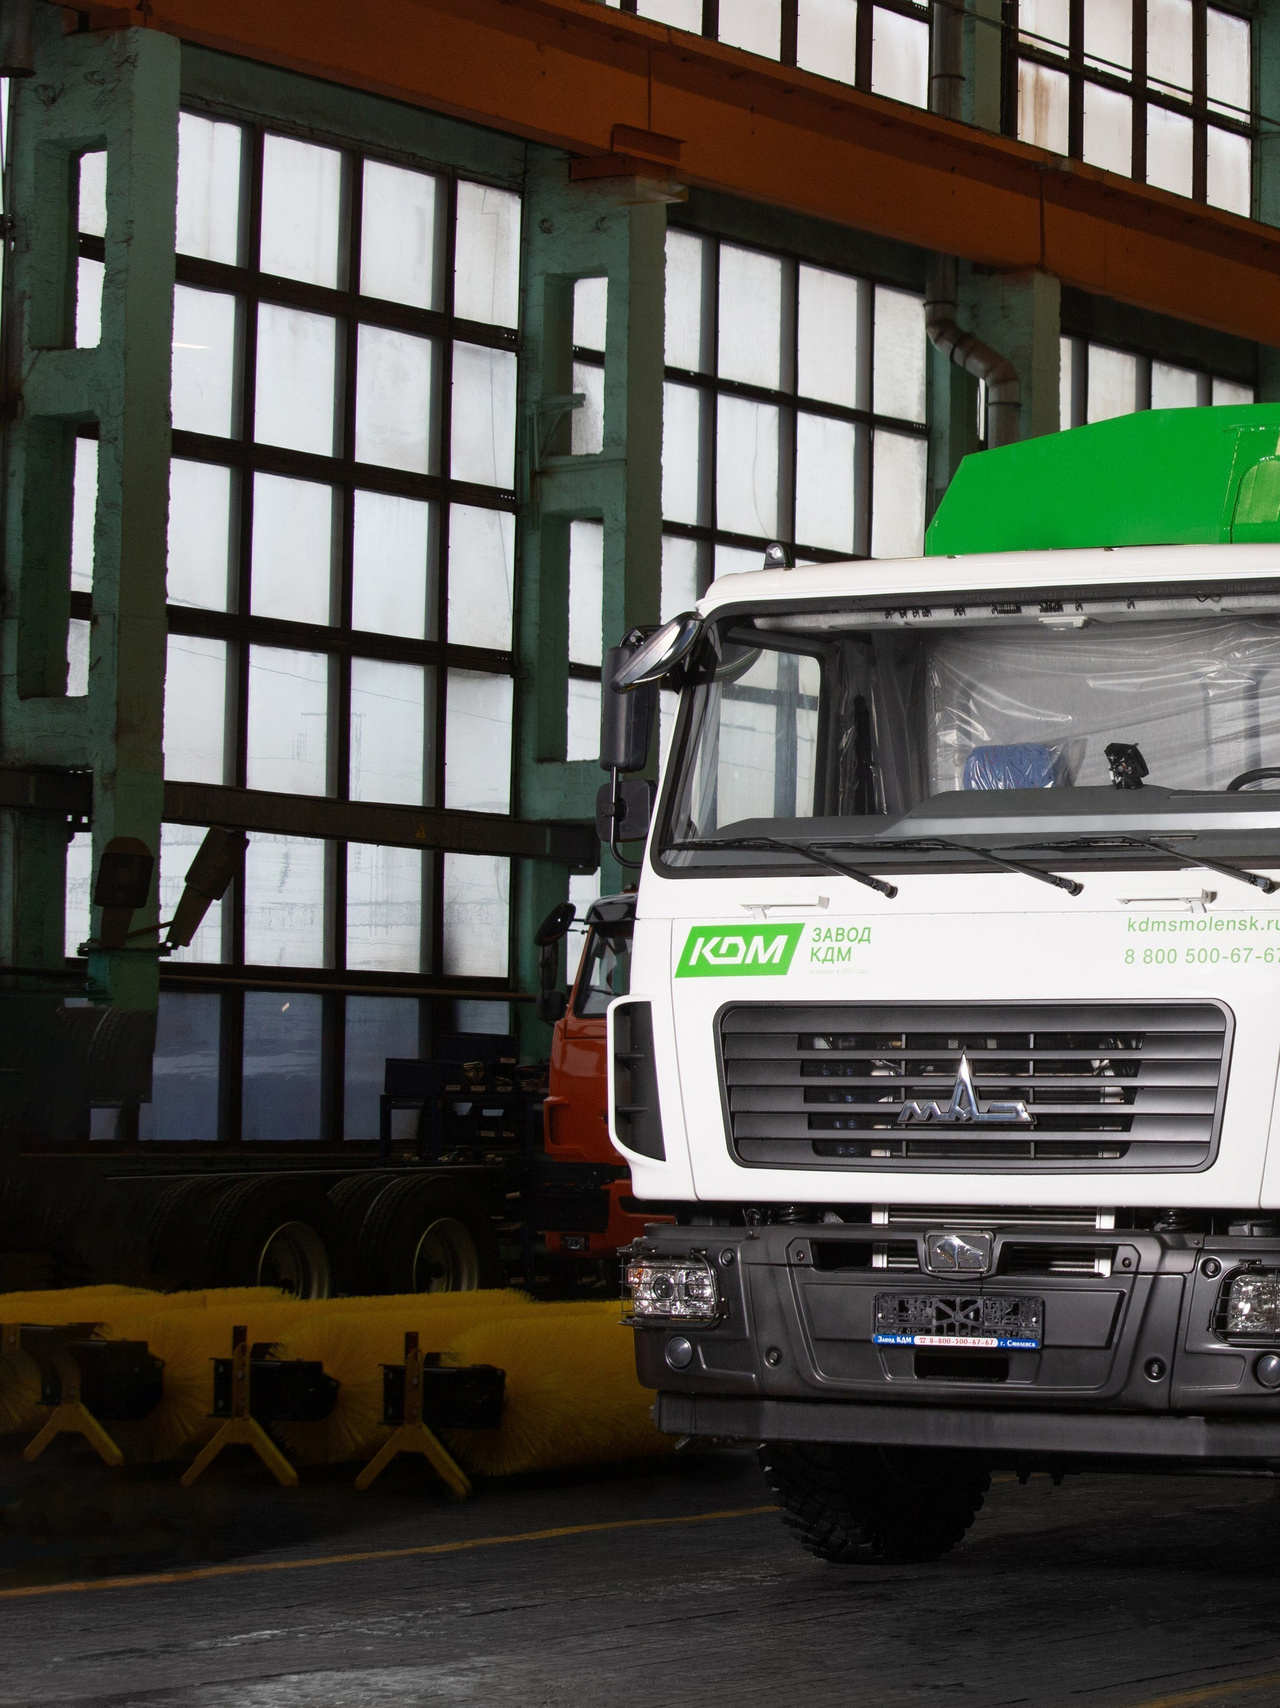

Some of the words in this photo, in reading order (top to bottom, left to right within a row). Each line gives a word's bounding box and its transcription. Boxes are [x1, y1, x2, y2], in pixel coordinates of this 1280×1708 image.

[811, 926, 872, 944] ЗАВОД
[810, 946, 853, 965] КДМ
[1124, 948, 1135, 964] 8
[1142, 948, 1178, 964] 800
[929, 1337, 994, 1346] 8-800-500-67-67
